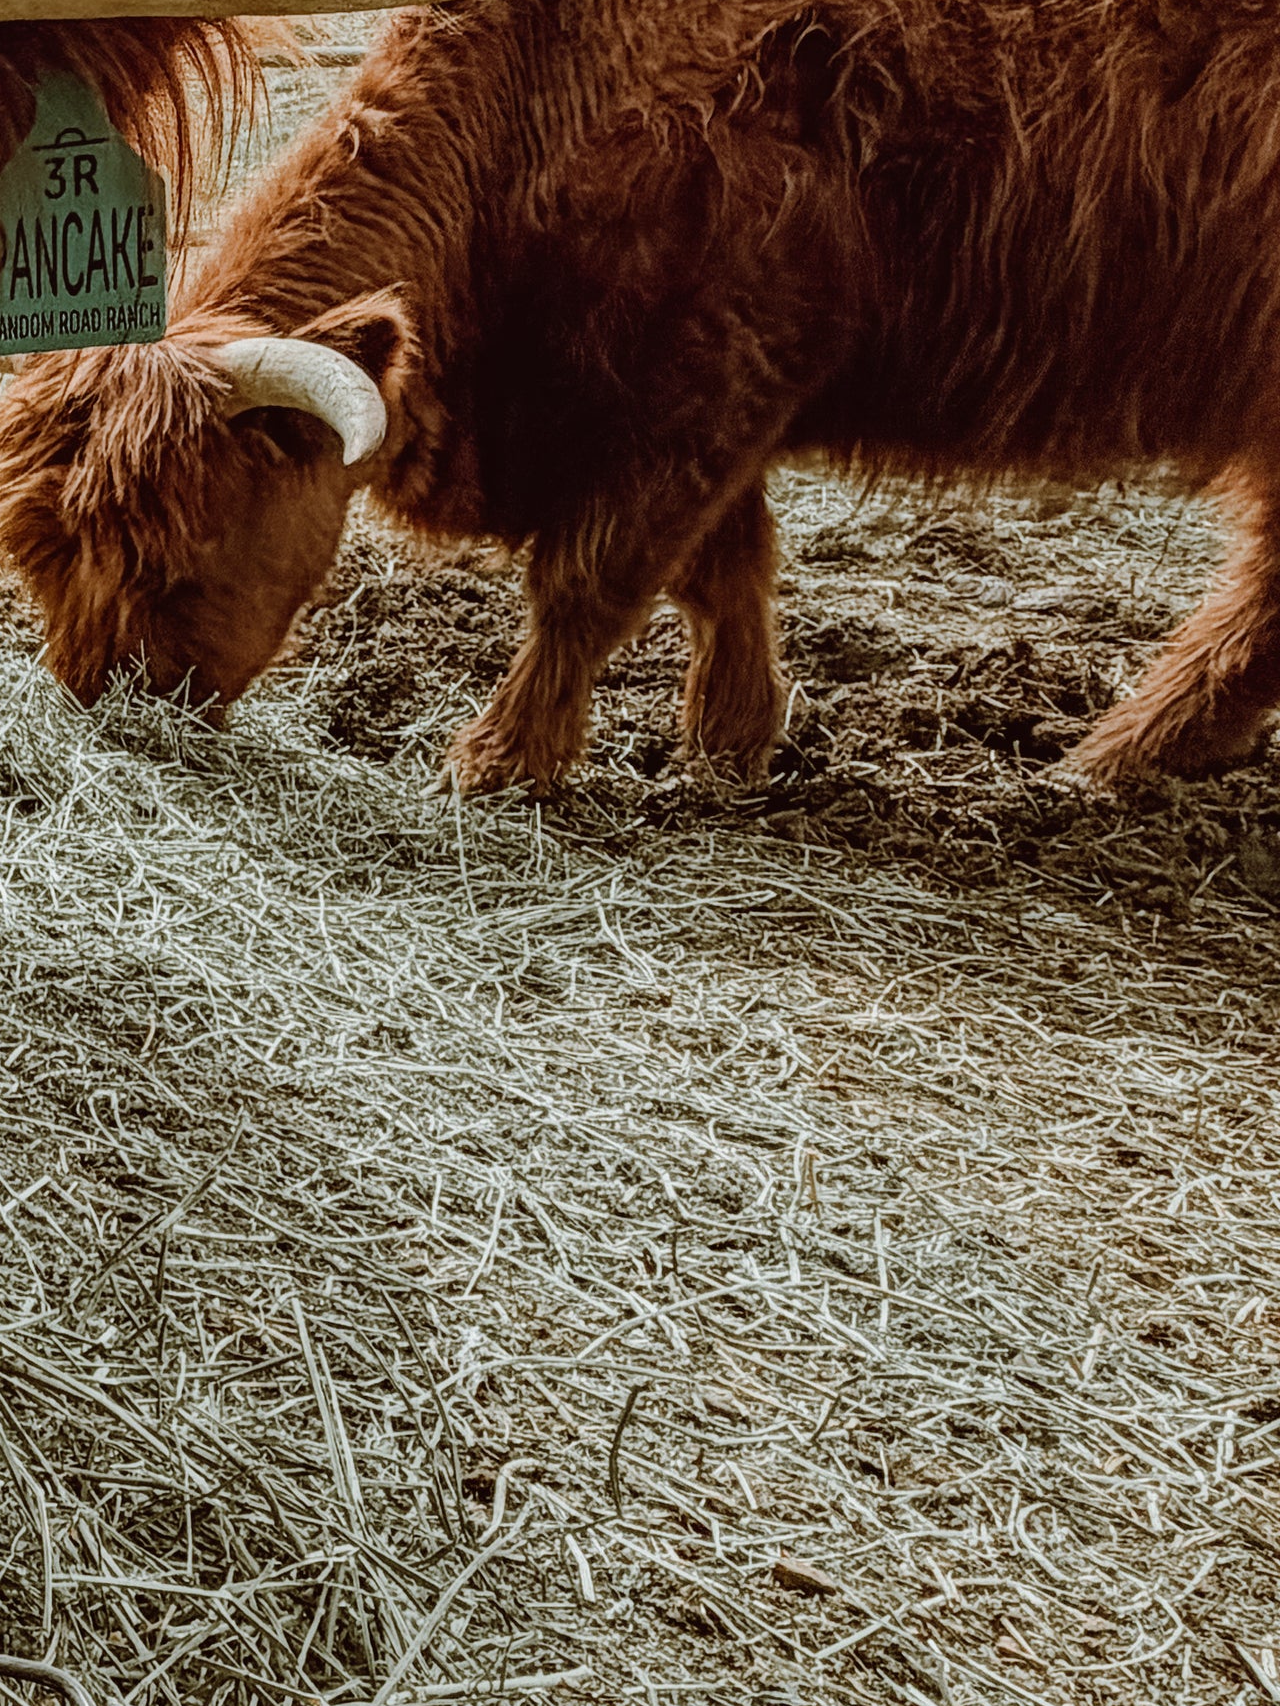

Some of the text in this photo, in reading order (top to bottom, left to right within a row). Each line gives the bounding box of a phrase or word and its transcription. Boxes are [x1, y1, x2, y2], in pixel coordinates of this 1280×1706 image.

[44, 154, 99, 200] 3R
[1, 203, 159, 302] ANCAKE
[59, 307, 102, 336] ROAD
[106, 302, 161, 330] RANCH
